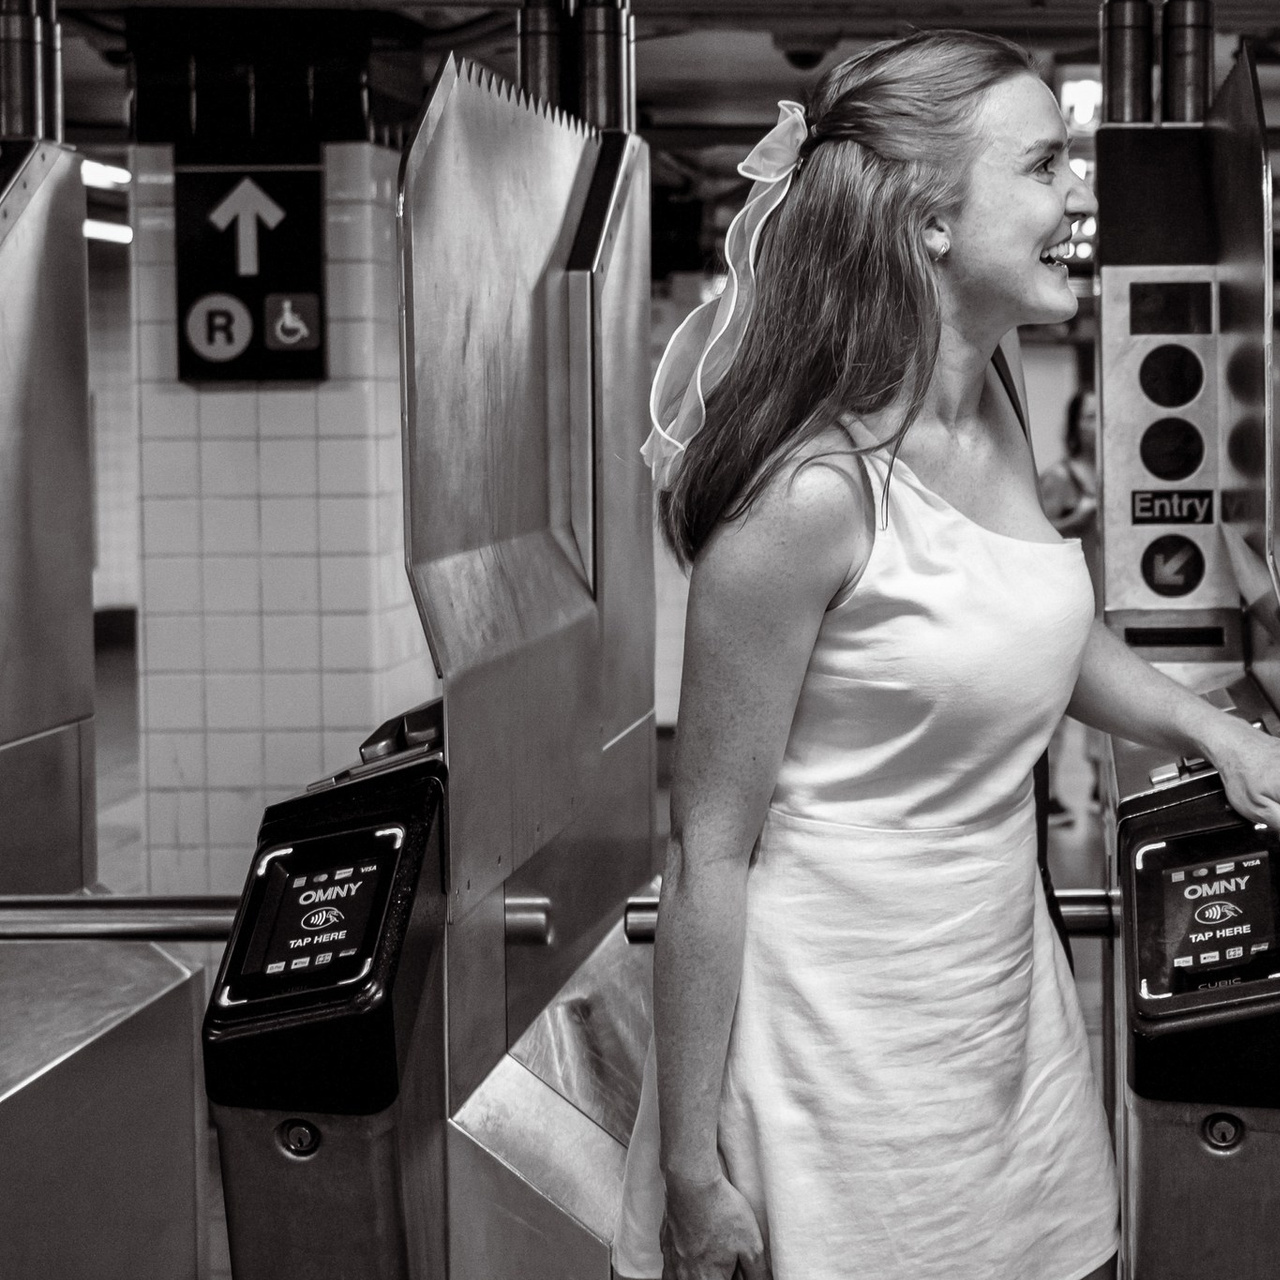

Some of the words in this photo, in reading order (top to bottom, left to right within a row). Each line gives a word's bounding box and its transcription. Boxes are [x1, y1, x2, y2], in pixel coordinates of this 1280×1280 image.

[207, 309, 235, 345] R
[1134, 492, 1210, 523] Entry
[360, 864, 377, 873] VISA
[1242, 859, 1261, 868] VISA
[298, 881, 363, 905] OMNY
[1183, 875, 1251, 900] OMNY
[289, 937, 312, 949] TAP
[313, 930, 347, 945] HERE
[1189, 931, 1214, 943] TAP
[1216, 924, 1252, 939] HERE
